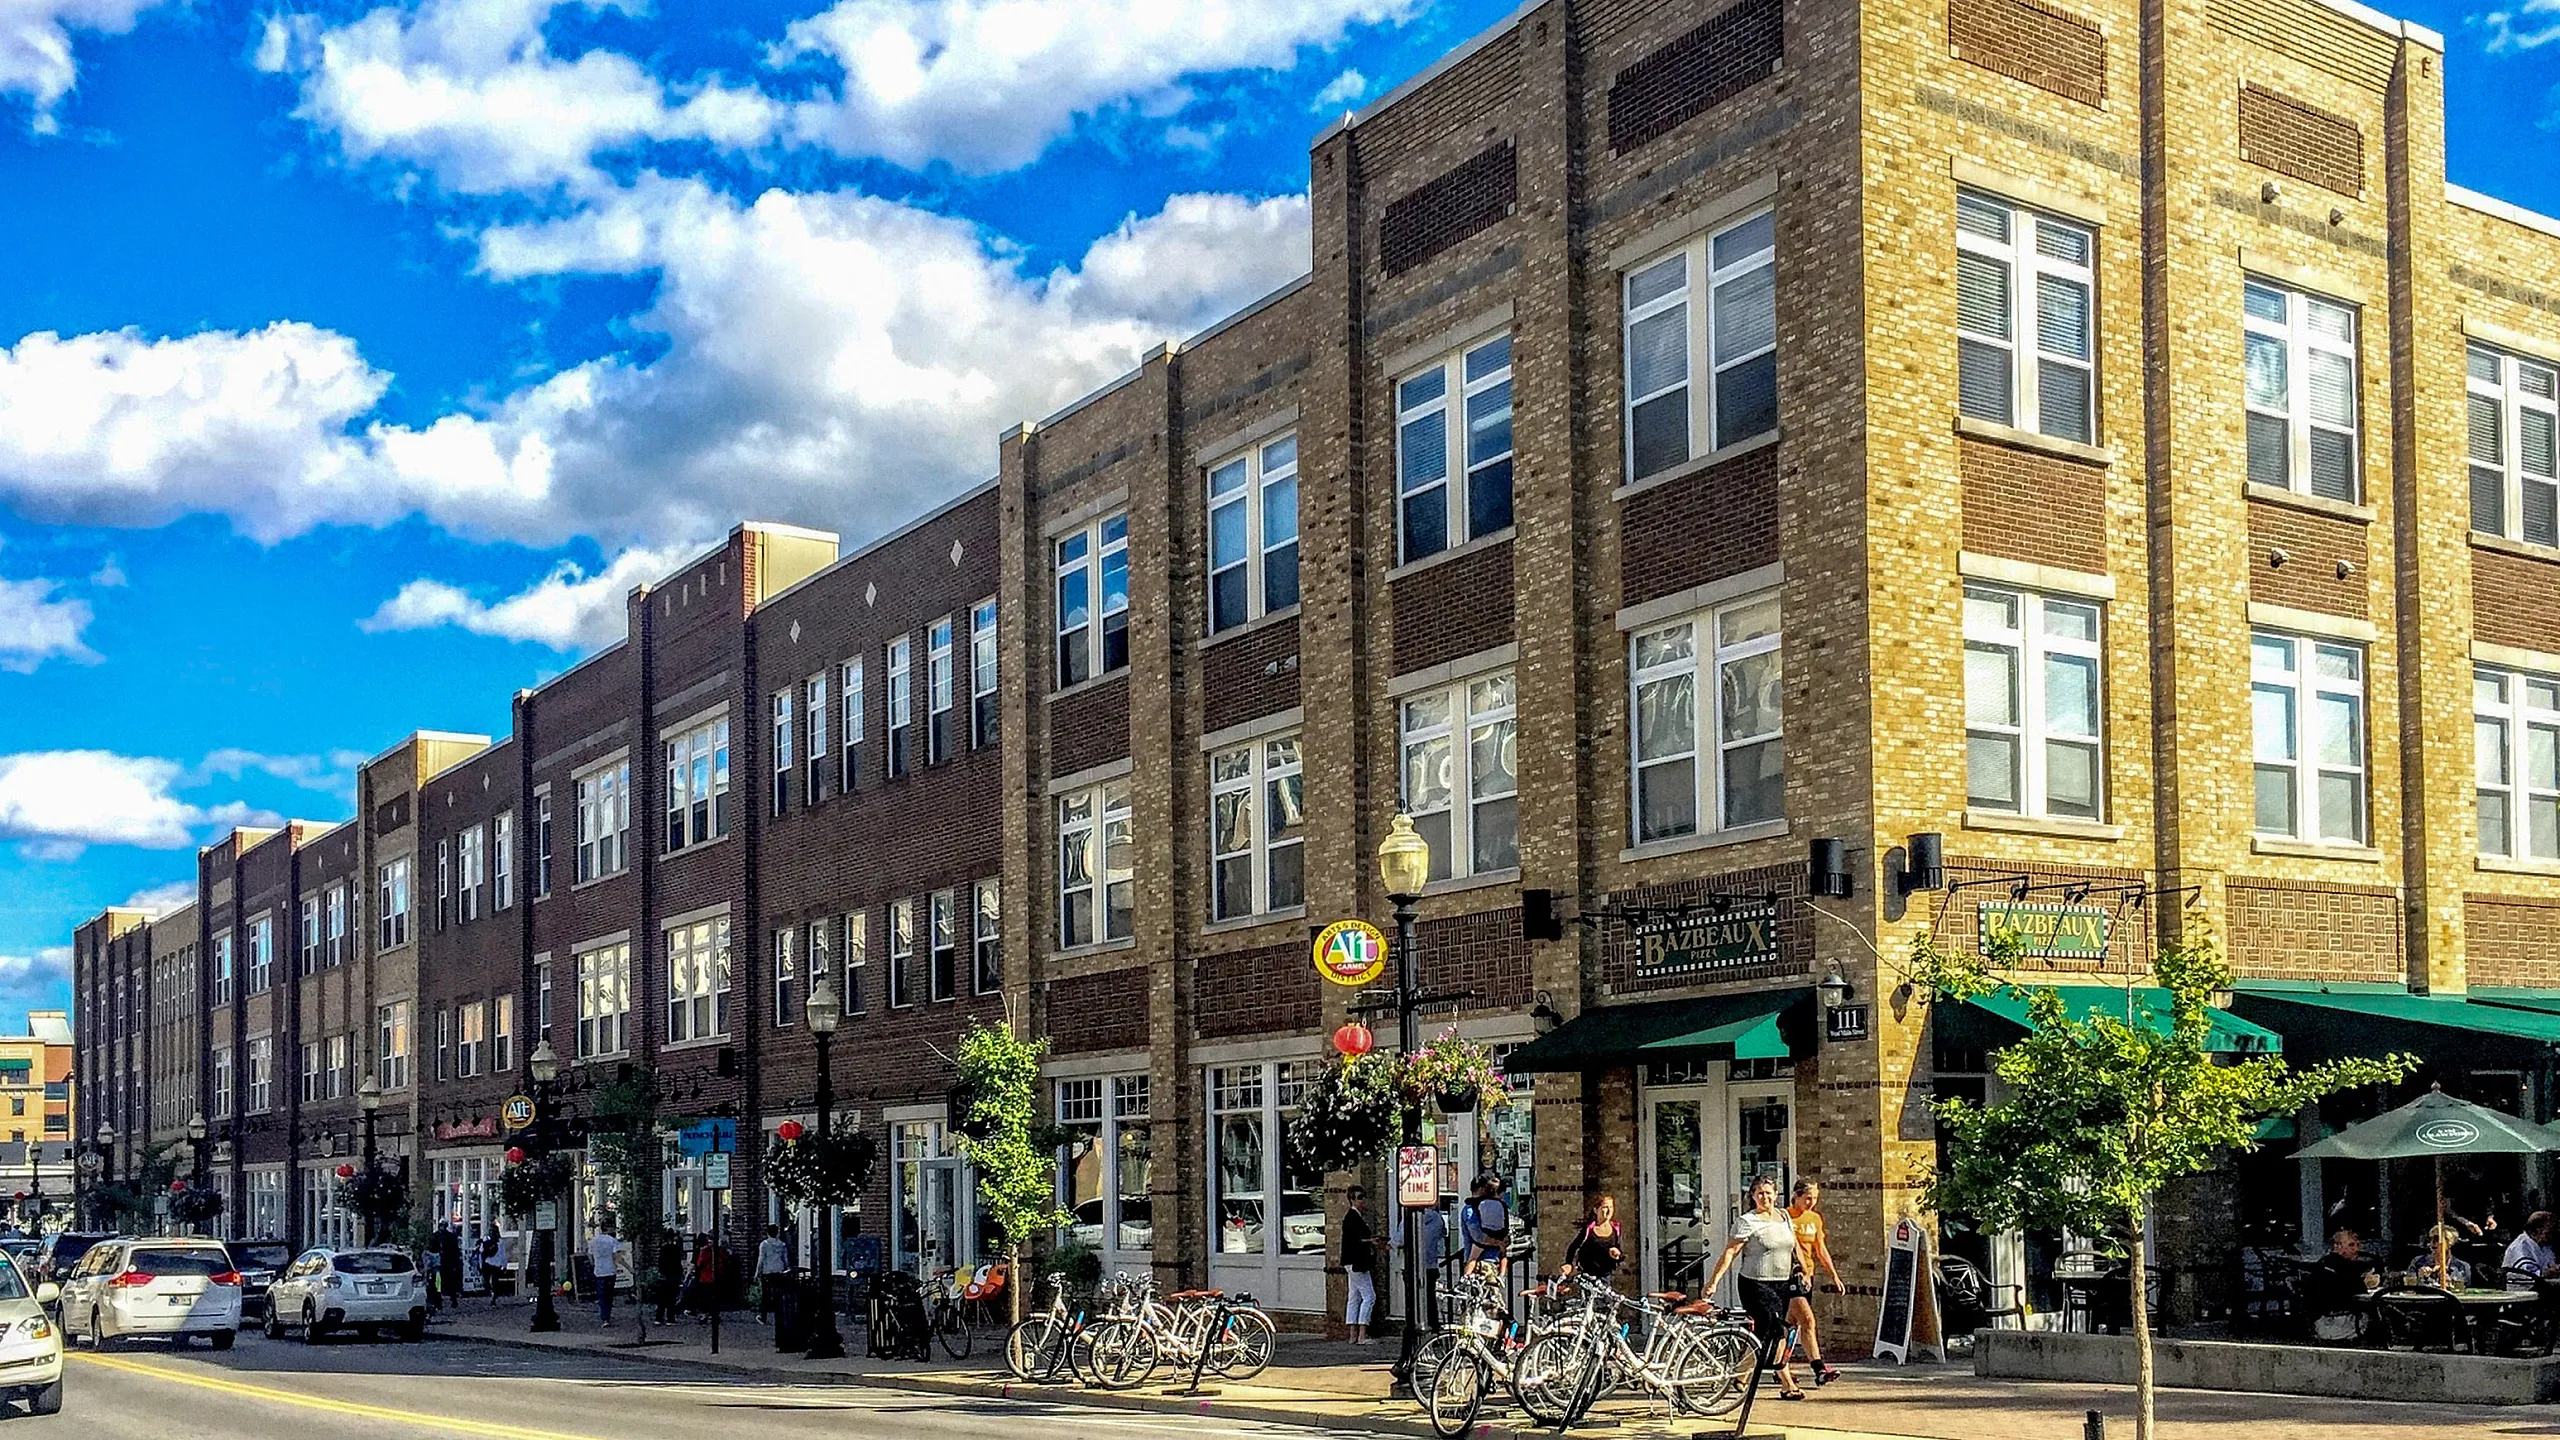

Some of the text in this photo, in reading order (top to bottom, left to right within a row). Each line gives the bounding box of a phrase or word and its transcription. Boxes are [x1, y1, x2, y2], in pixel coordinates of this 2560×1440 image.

[1322, 924, 1342, 942] ARTS
[1350, 921, 1381, 940] DESIGN
[1643, 919, 1768, 966] BAZBEAUX
[1690, 948, 1717, 960] PIZZA
[1336, 963, 1368, 971] CARMEL
[1330, 971, 1372, 982] DISTRICT
[1836, 1009, 1859, 1029] 111
[1409, 1166, 1431, 1178] ANY
[1407, 1182, 1430, 1193] TIME
